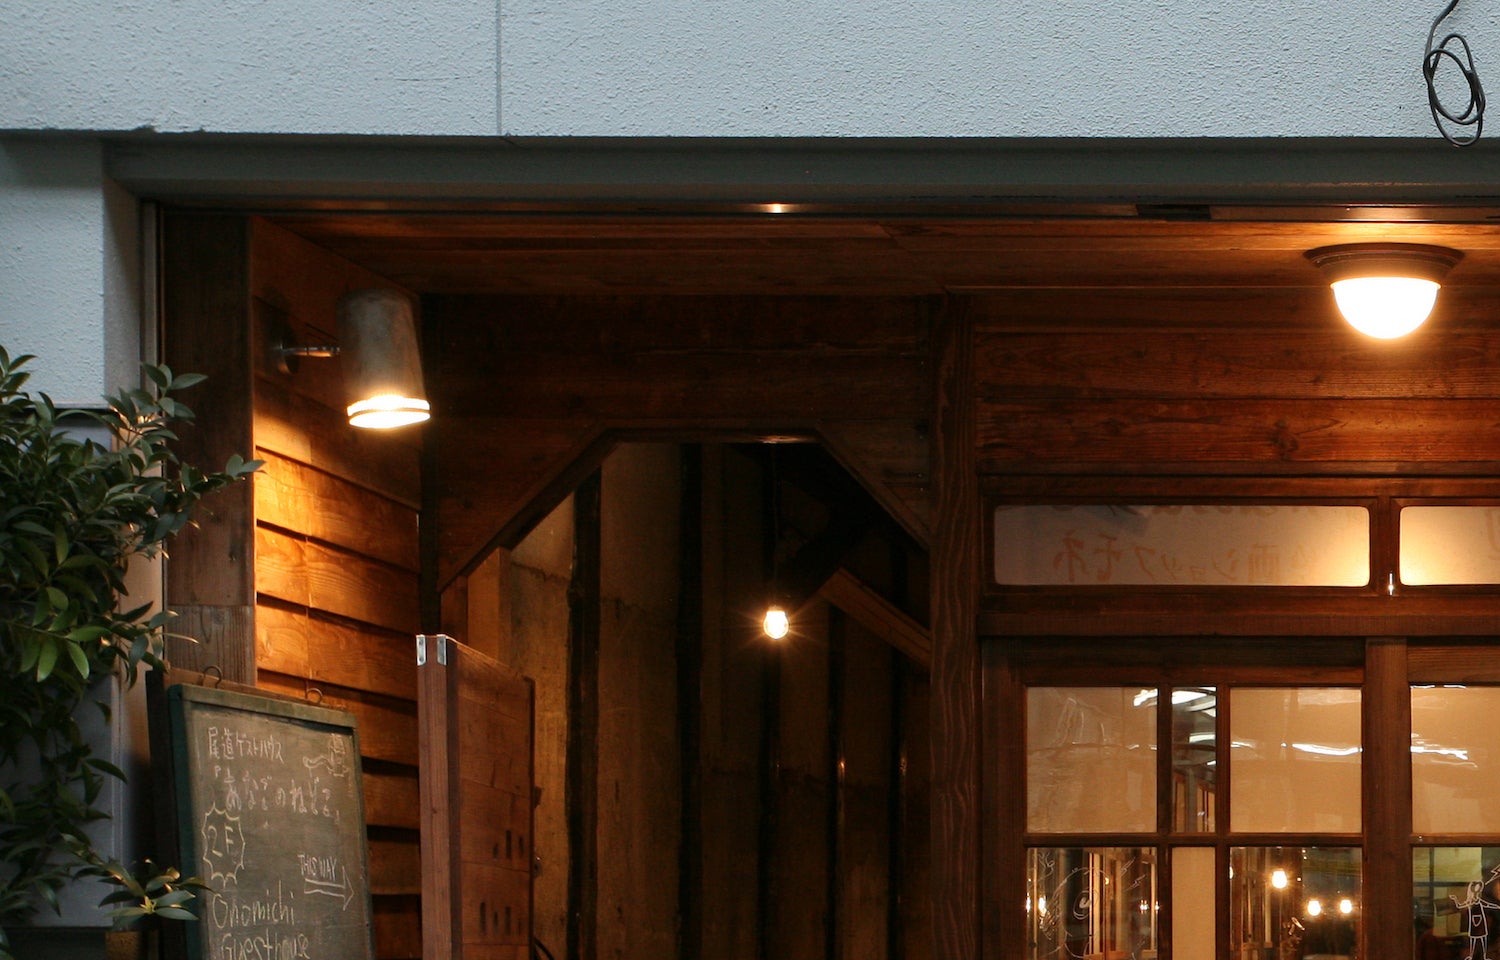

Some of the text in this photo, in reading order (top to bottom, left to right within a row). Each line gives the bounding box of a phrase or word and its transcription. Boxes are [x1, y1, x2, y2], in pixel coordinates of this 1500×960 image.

[207, 726, 284, 764] 尾道ゲストハウス
[207, 824, 233, 858] 2F
[297, 853, 337, 881] THIS WAY
[212, 879, 295, 929] Onomichi
